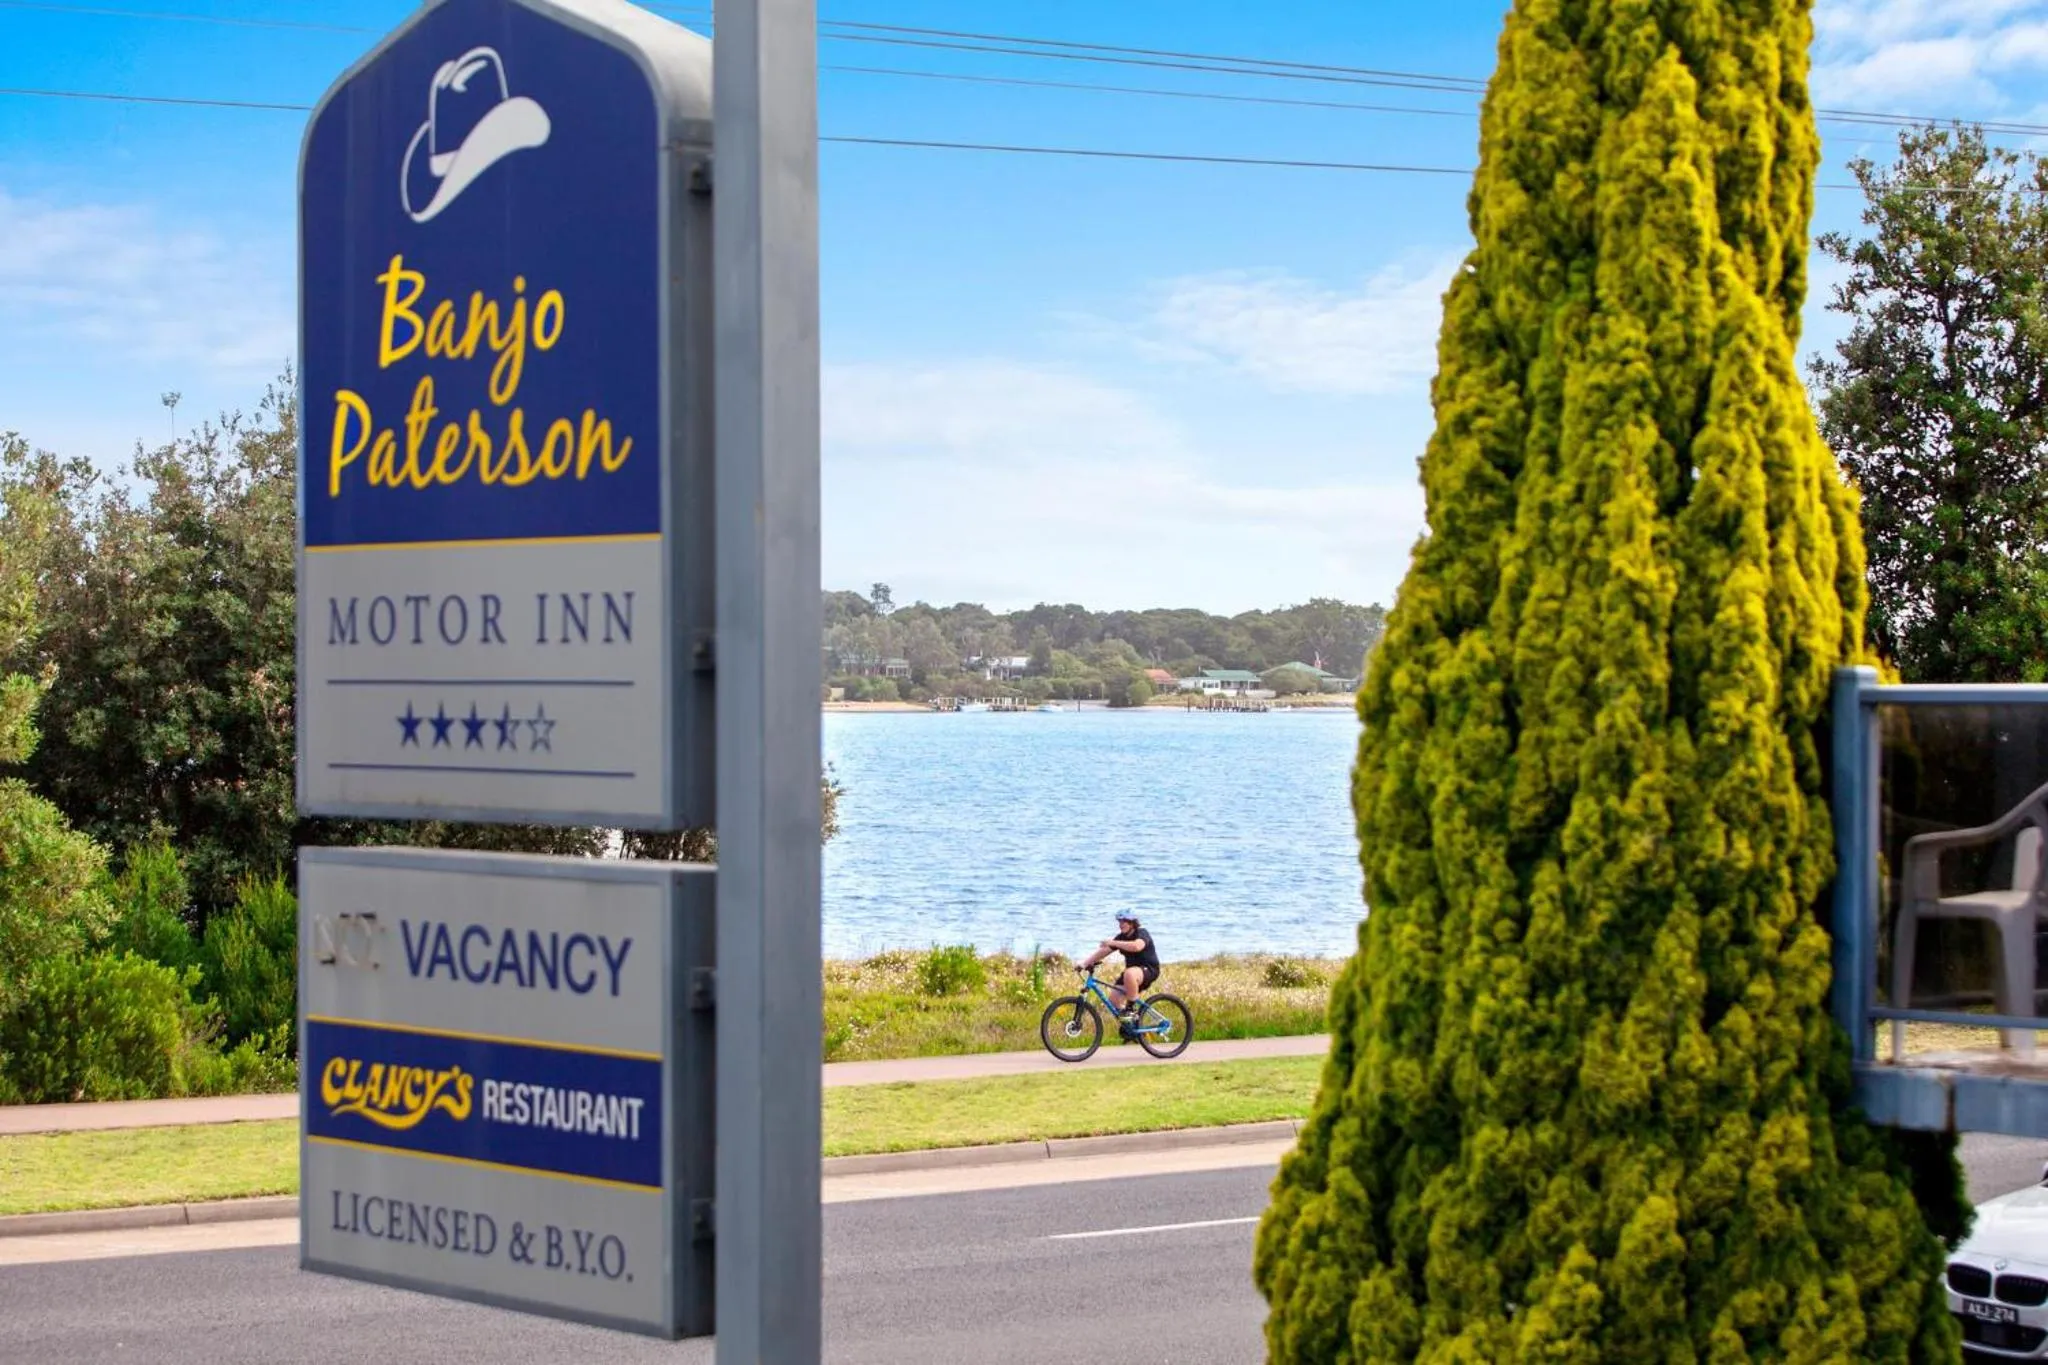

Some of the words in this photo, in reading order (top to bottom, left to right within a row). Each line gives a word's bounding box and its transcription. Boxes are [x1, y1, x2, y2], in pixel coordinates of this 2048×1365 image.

[375, 254, 565, 405] Banjo
[328, 375, 633, 498] Paterson
[327, 594, 507, 645] MOTOR
[536, 591, 635, 645] INN
[400, 919, 634, 997] VACANCY
[321, 1056, 475, 1131] CLANCY'S
[481, 1079, 645, 1140] RESTAURANT
[331, 1190, 498, 1256] LICENSED
[508, 1221, 535, 1265] &
[544, 1225, 635, 1283] B.Y.O.
